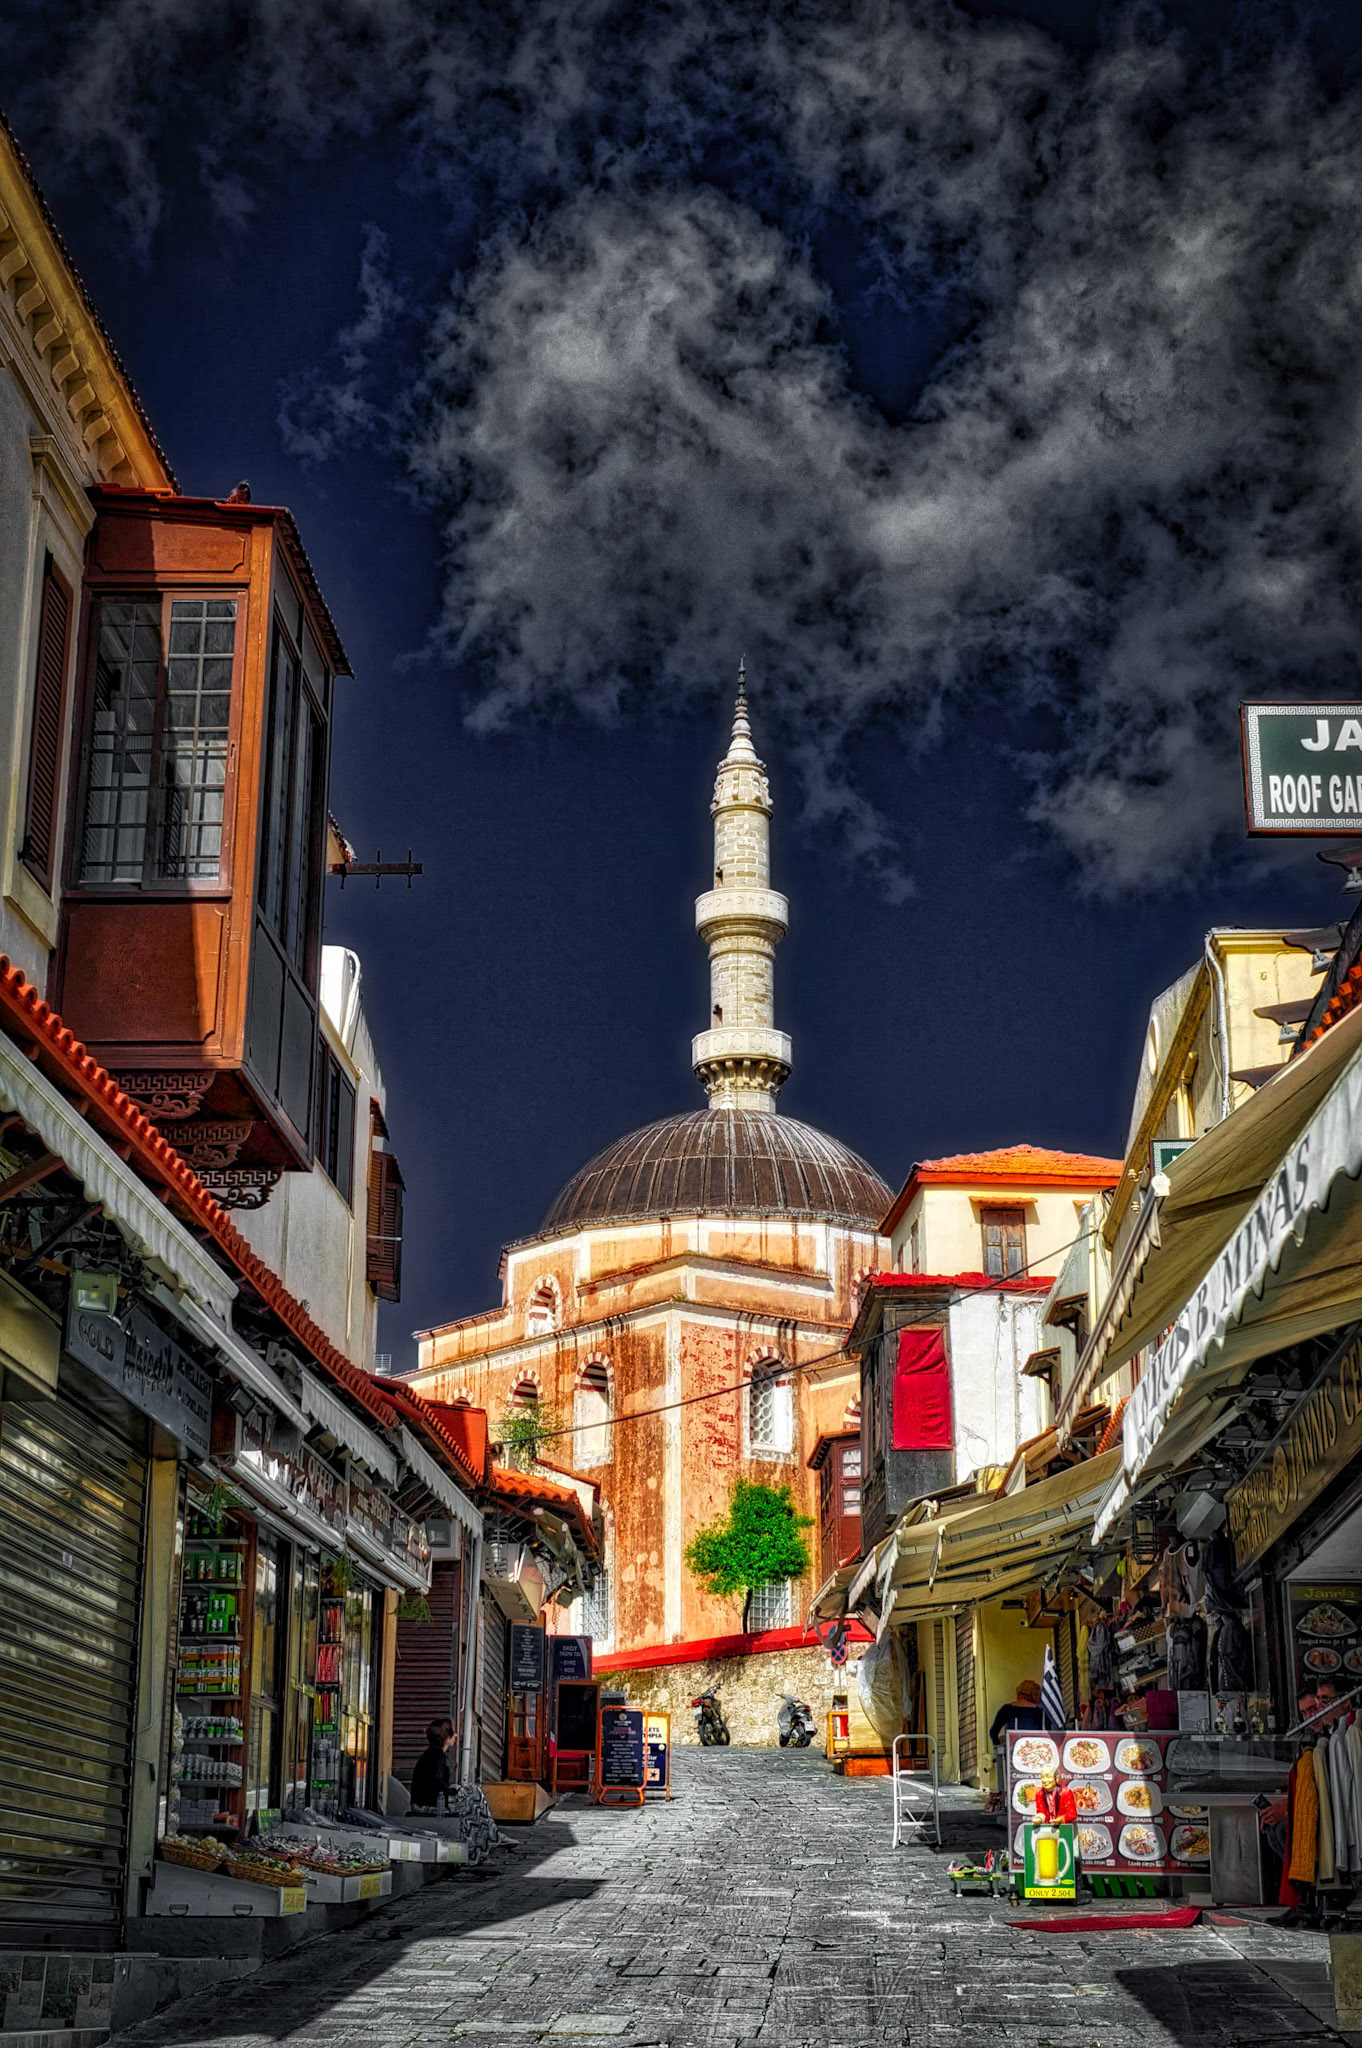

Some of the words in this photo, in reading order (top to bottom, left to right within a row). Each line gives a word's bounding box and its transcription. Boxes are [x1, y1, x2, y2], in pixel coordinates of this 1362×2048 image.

[1300, 719, 1362, 752] JA
[1269, 774, 1322, 813] ROOF
[1220, 1133, 1311, 1310] MINAS
[1289, 1377, 1338, 1502] JANNIS
[1029, 1889, 1049, 1897] ONLY
